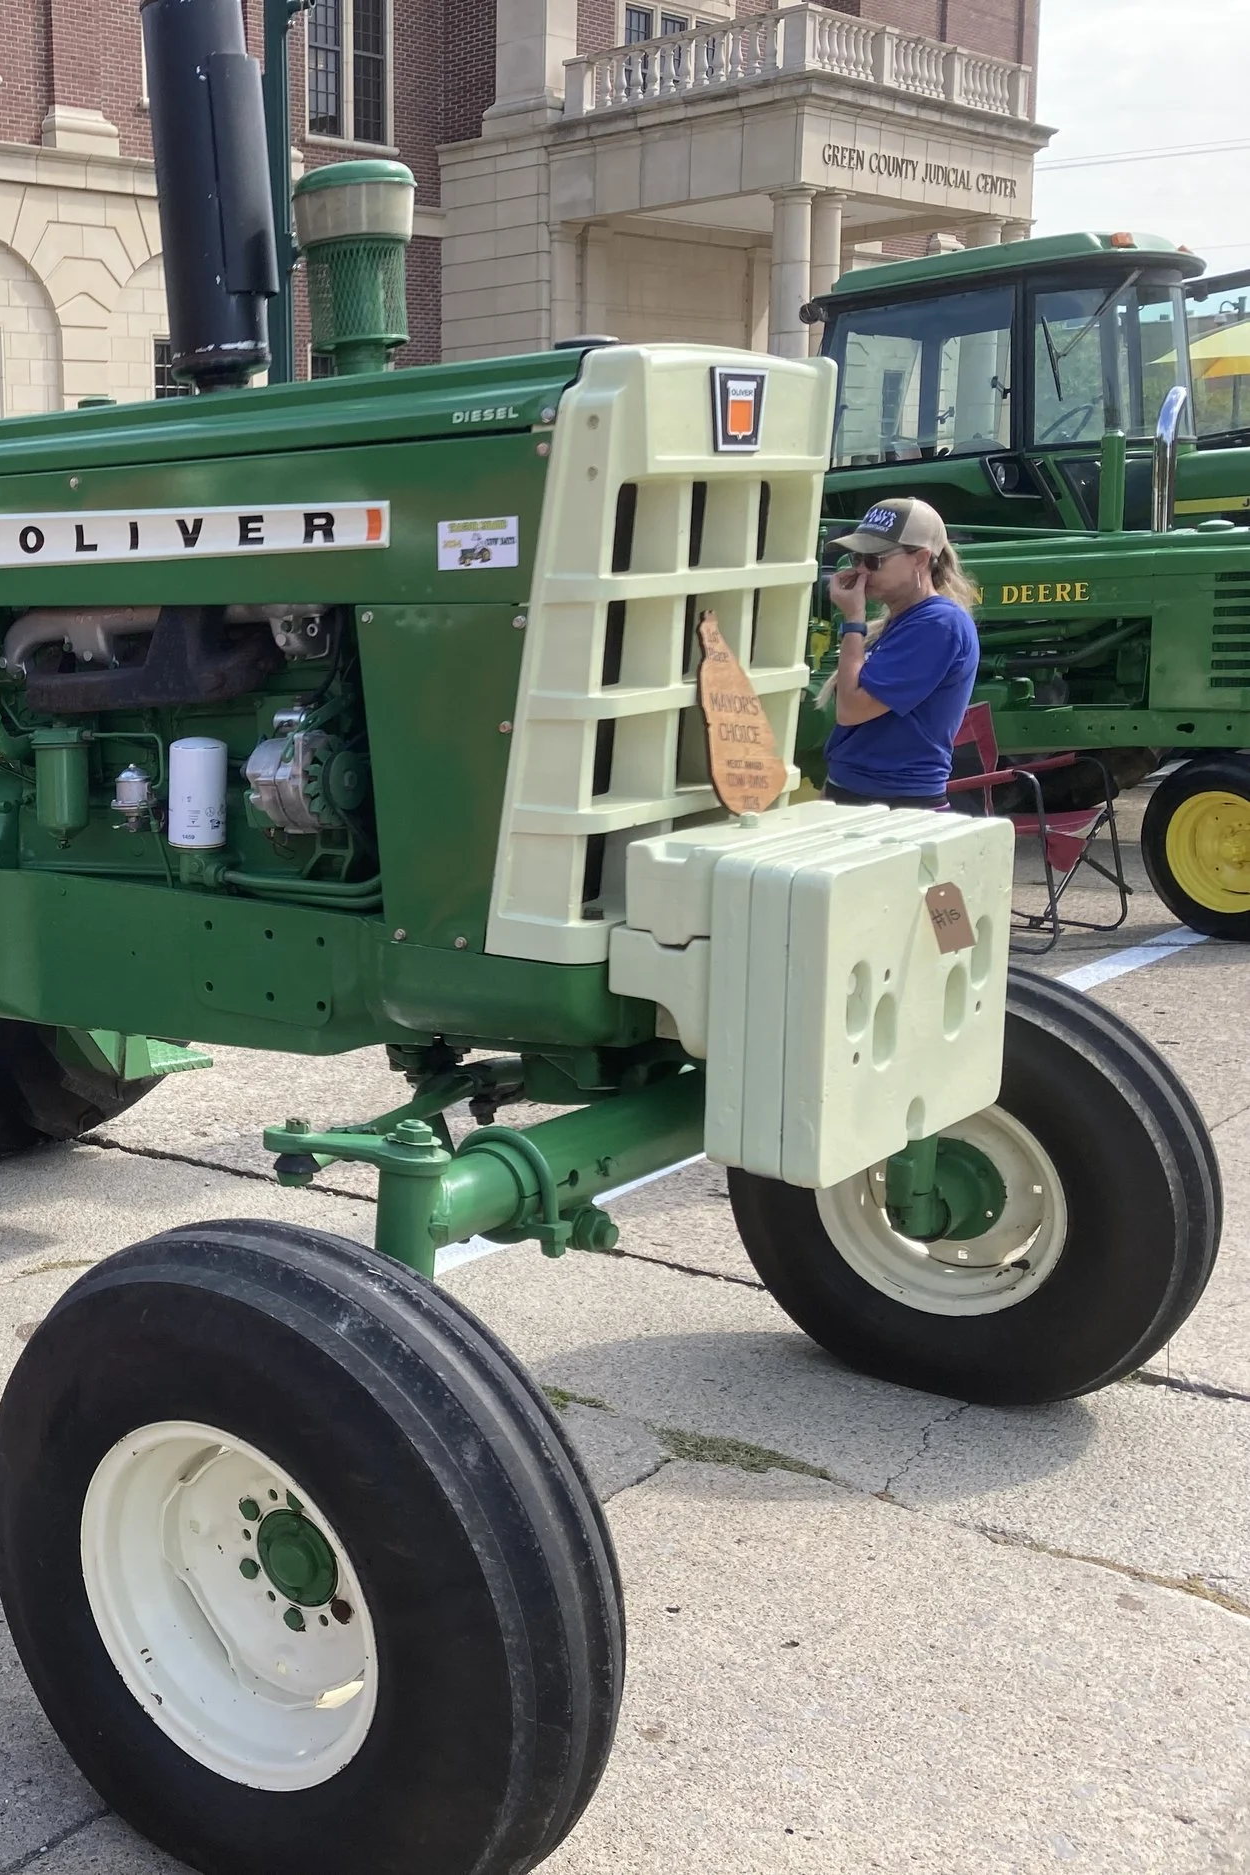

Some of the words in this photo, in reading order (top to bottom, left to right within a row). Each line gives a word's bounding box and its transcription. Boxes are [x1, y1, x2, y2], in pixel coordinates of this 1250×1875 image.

[823, 144, 865, 171] GREEN
[869, 152, 918, 181] COUNTY
[921, 162, 972, 191] JUDICIAL
[976, 172, 1017, 198] CENTER
[452, 406, 519, 424] DIESEL
[18, 511, 335, 555] OLIVER
[1001, 582, 1090, 605] DEERE
[718, 723, 761, 745] CHOICE
